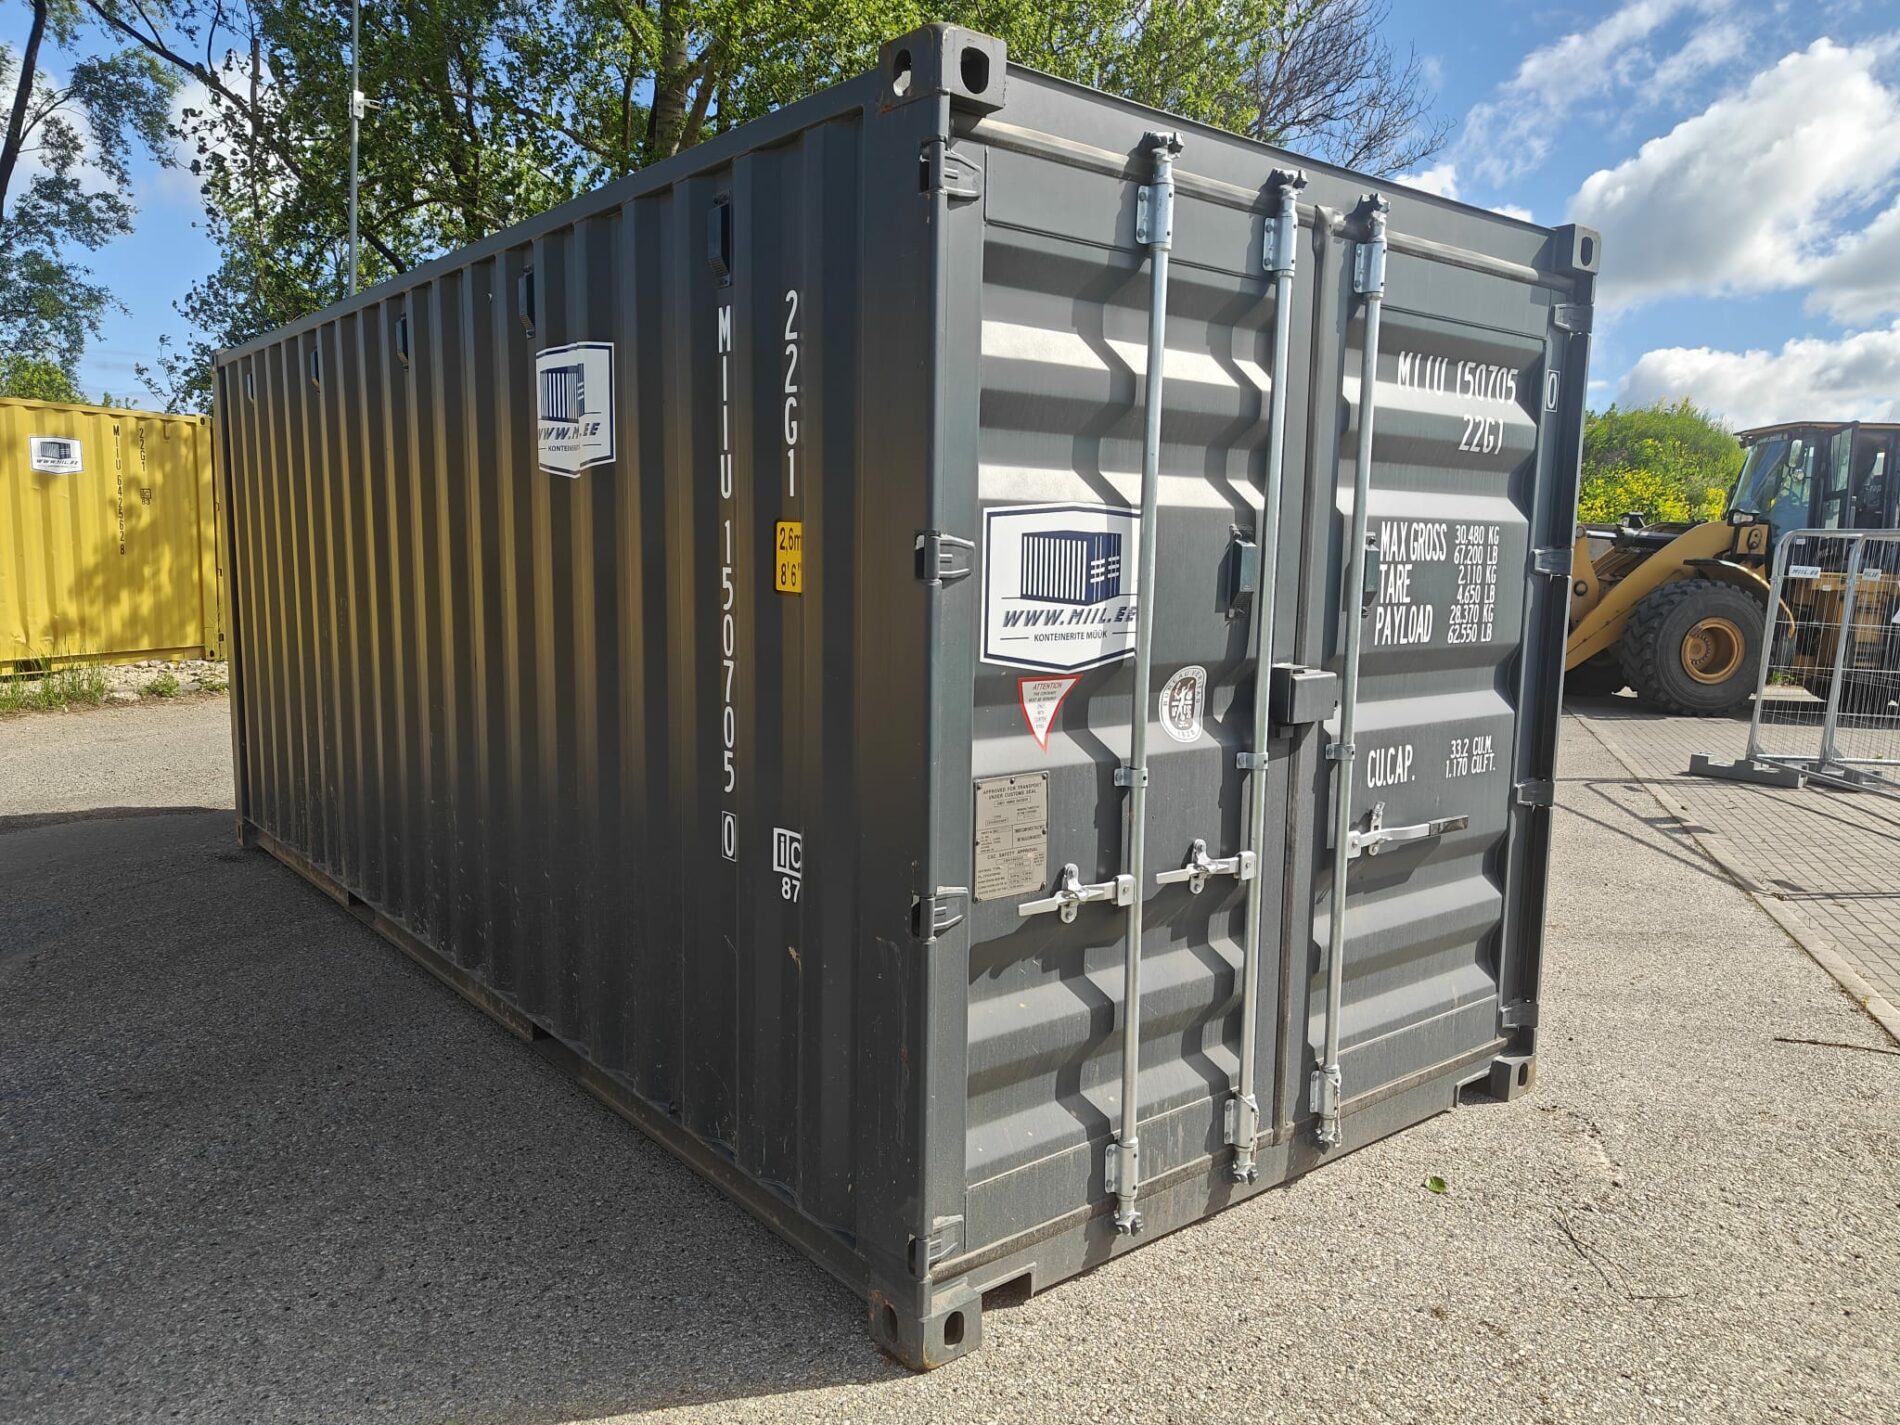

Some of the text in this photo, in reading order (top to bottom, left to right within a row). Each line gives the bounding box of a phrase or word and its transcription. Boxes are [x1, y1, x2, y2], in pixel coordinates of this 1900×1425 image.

[784, 289, 799, 497] 22G1
[1397, 351, 1449, 396] MIIU
[1456, 360, 1520, 405] 150705
[718, 305, 732, 499] MIIU
[1458, 413, 1504, 455] 22G1
[1380, 521, 1447, 562] MAX GROSS
[1488, 526, 1499, 545] KG
[1487, 546, 1498, 564] LB
[1379, 564, 1412, 604] TARE
[1485, 565, 1497, 584] KG
[1484, 585, 1495, 603] LB
[1374, 604, 1433, 646] PAYLOAD
[1483, 604, 1494, 623] KG
[1034, 630, 1108, 642] KONTEINERITE MÜÜK
[1481, 623, 1492, 642] LB
[722, 519, 736, 793] 150705
[1450, 738, 1469, 758] 33.2
[1367, 744, 1415, 788] CU.CAP.
[782, 876, 800, 903] 87
